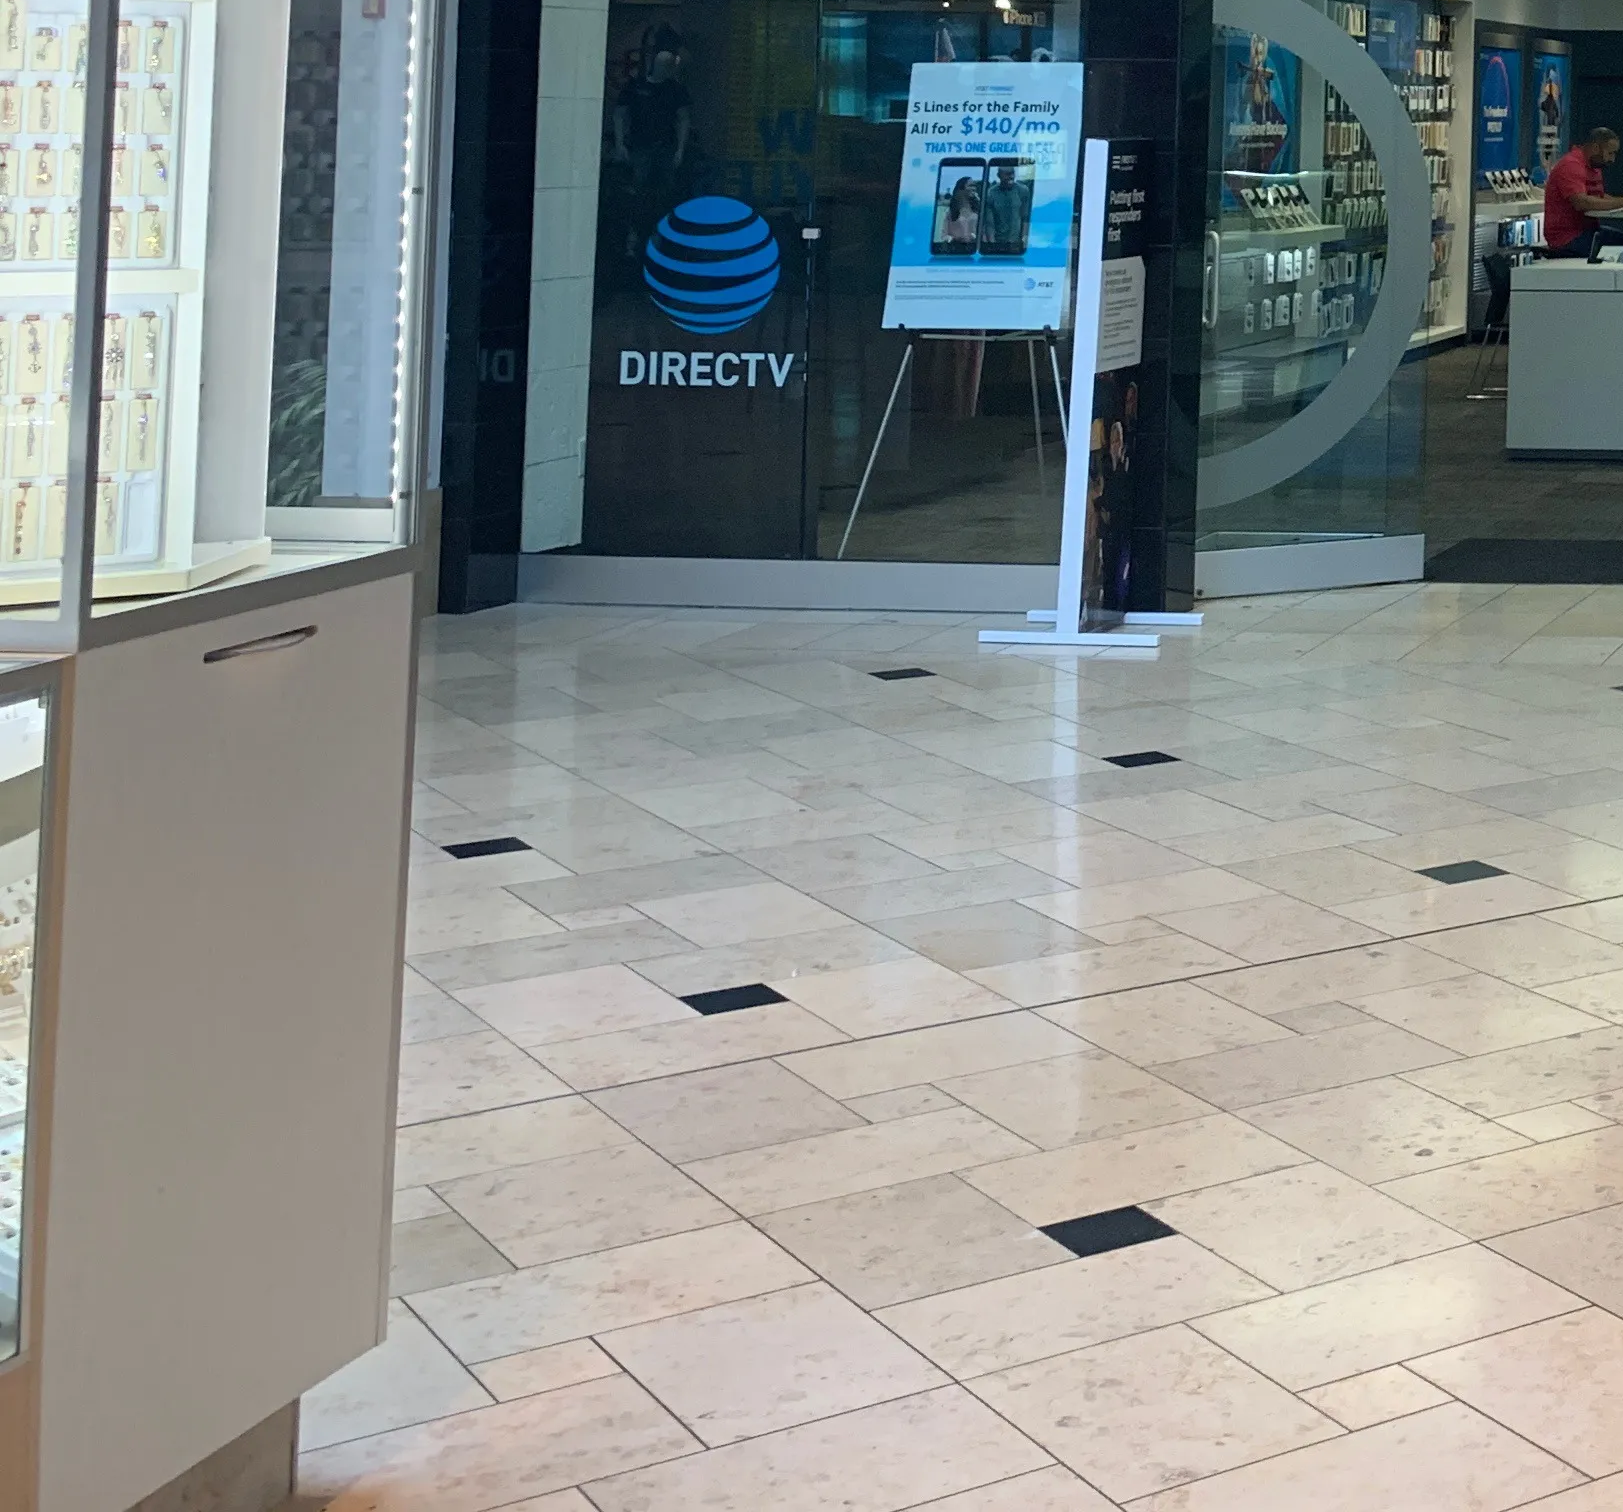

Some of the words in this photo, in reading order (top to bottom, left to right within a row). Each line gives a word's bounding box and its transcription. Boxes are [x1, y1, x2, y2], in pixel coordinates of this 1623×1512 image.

[913, 102, 921, 113] 5
[924, 101, 959, 113] Lines
[962, 100, 984, 113] for
[987, 101, 1010, 113] the
[1013, 101, 1060, 116] Family
[910, 123, 929, 135] All
[931, 122, 953, 135] for
[960, 115, 1061, 138] $140/mo
[924, 141, 962, 154] THAT'S
[965, 141, 986, 154] ONE
[989, 141, 1023, 154] GREAT
[619, 350, 795, 388] DIRECTV
